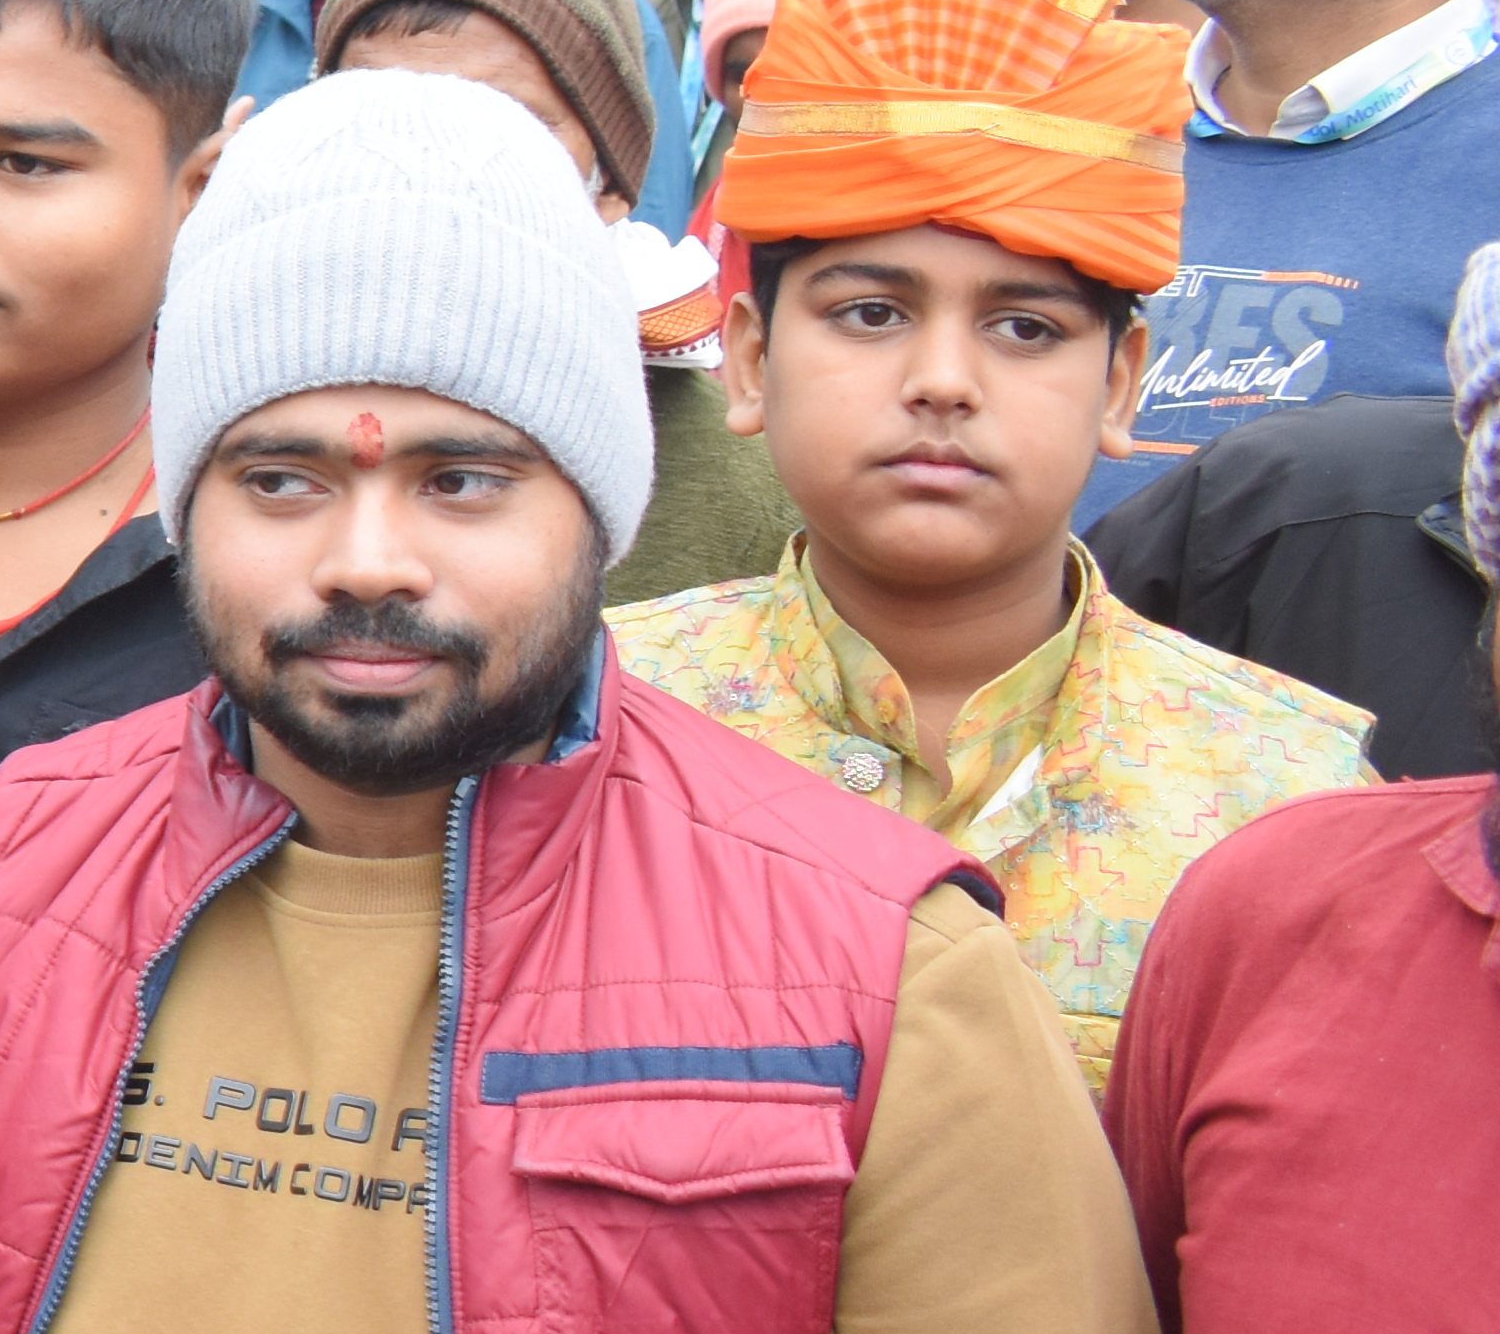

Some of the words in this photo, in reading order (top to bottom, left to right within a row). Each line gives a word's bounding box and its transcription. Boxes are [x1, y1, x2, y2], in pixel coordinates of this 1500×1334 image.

[1345, 75, 1419, 126] Motihari
[202, 1075, 378, 1145] POLO
[114, 1130, 281, 1195] DENIM
